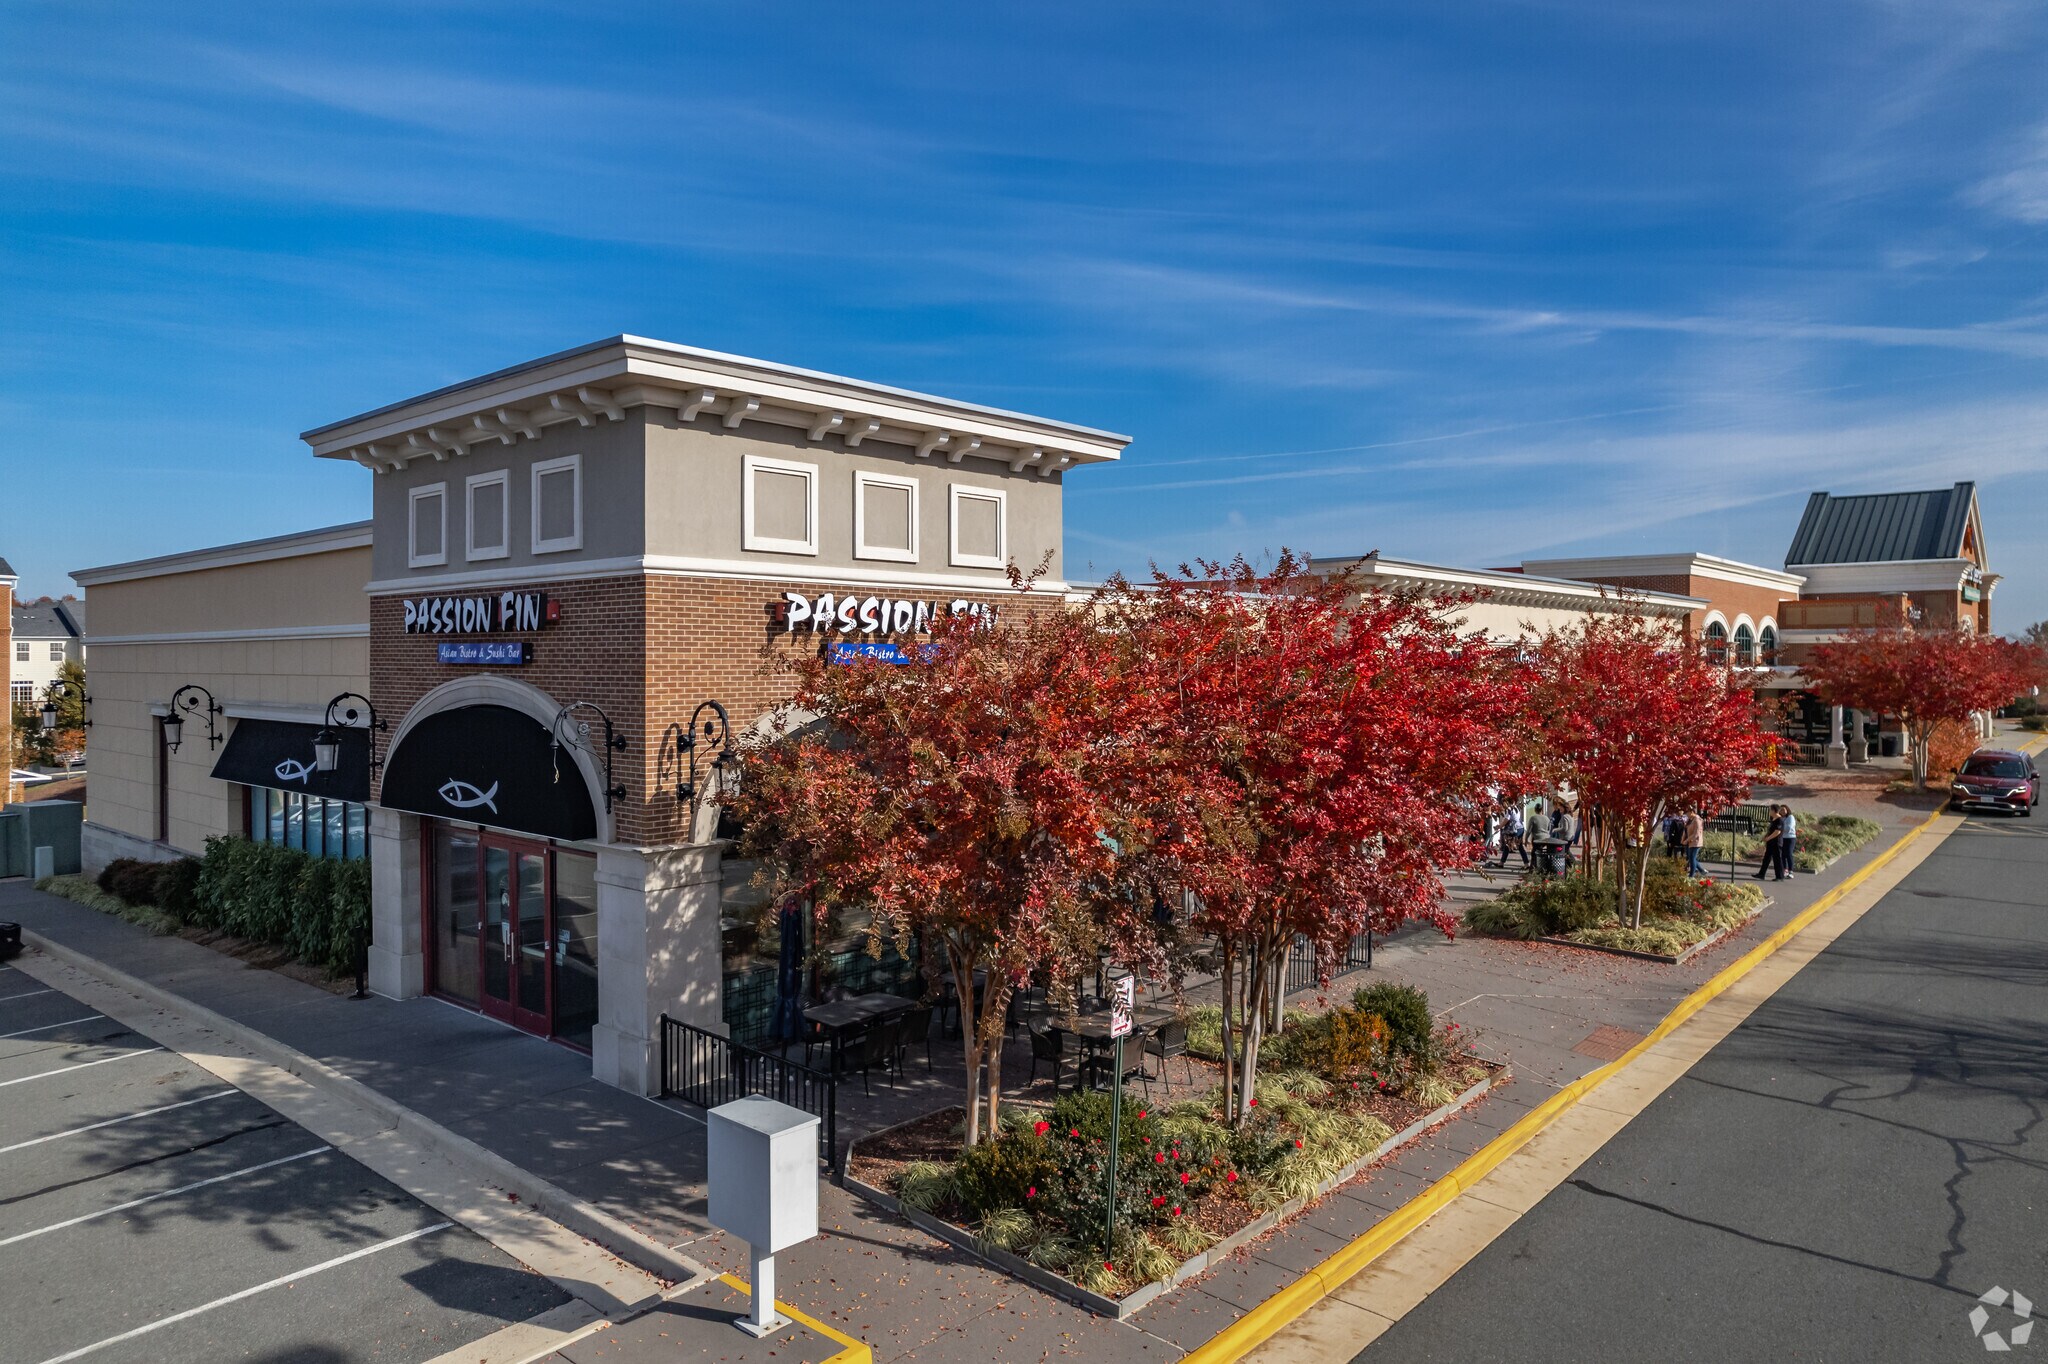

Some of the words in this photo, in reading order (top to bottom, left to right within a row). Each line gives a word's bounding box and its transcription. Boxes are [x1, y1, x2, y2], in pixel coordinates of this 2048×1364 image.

[403, 597, 491, 634] PASSION
[501, 592, 540, 632] FIN
[786, 592, 938, 635] PASSION
[440, 646, 457, 660] Asian
[459, 645, 477, 658] Bistro
[486, 644, 505, 660] Sushi
[507, 645, 520, 658] Bar
[865, 646, 894, 660] Bistro
